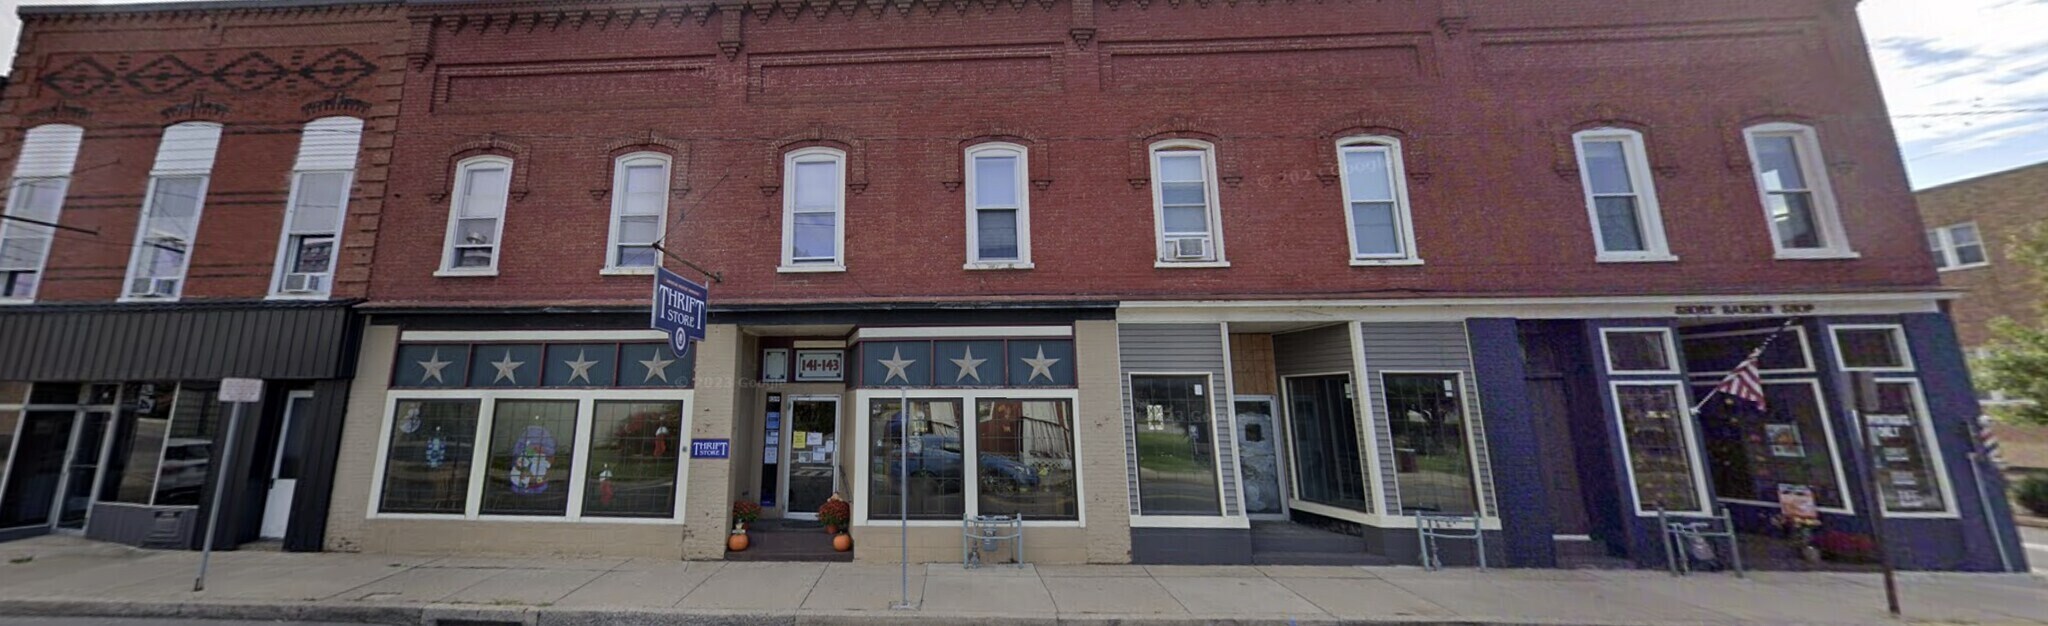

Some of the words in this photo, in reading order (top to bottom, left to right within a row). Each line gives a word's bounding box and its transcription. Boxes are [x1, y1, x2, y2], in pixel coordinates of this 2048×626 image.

[659, 284, 705, 330] THRIFT
[667, 309, 695, 328] STORE
[802, 359, 839, 371] 141-143
[693, 442, 728, 456] THRIFT
